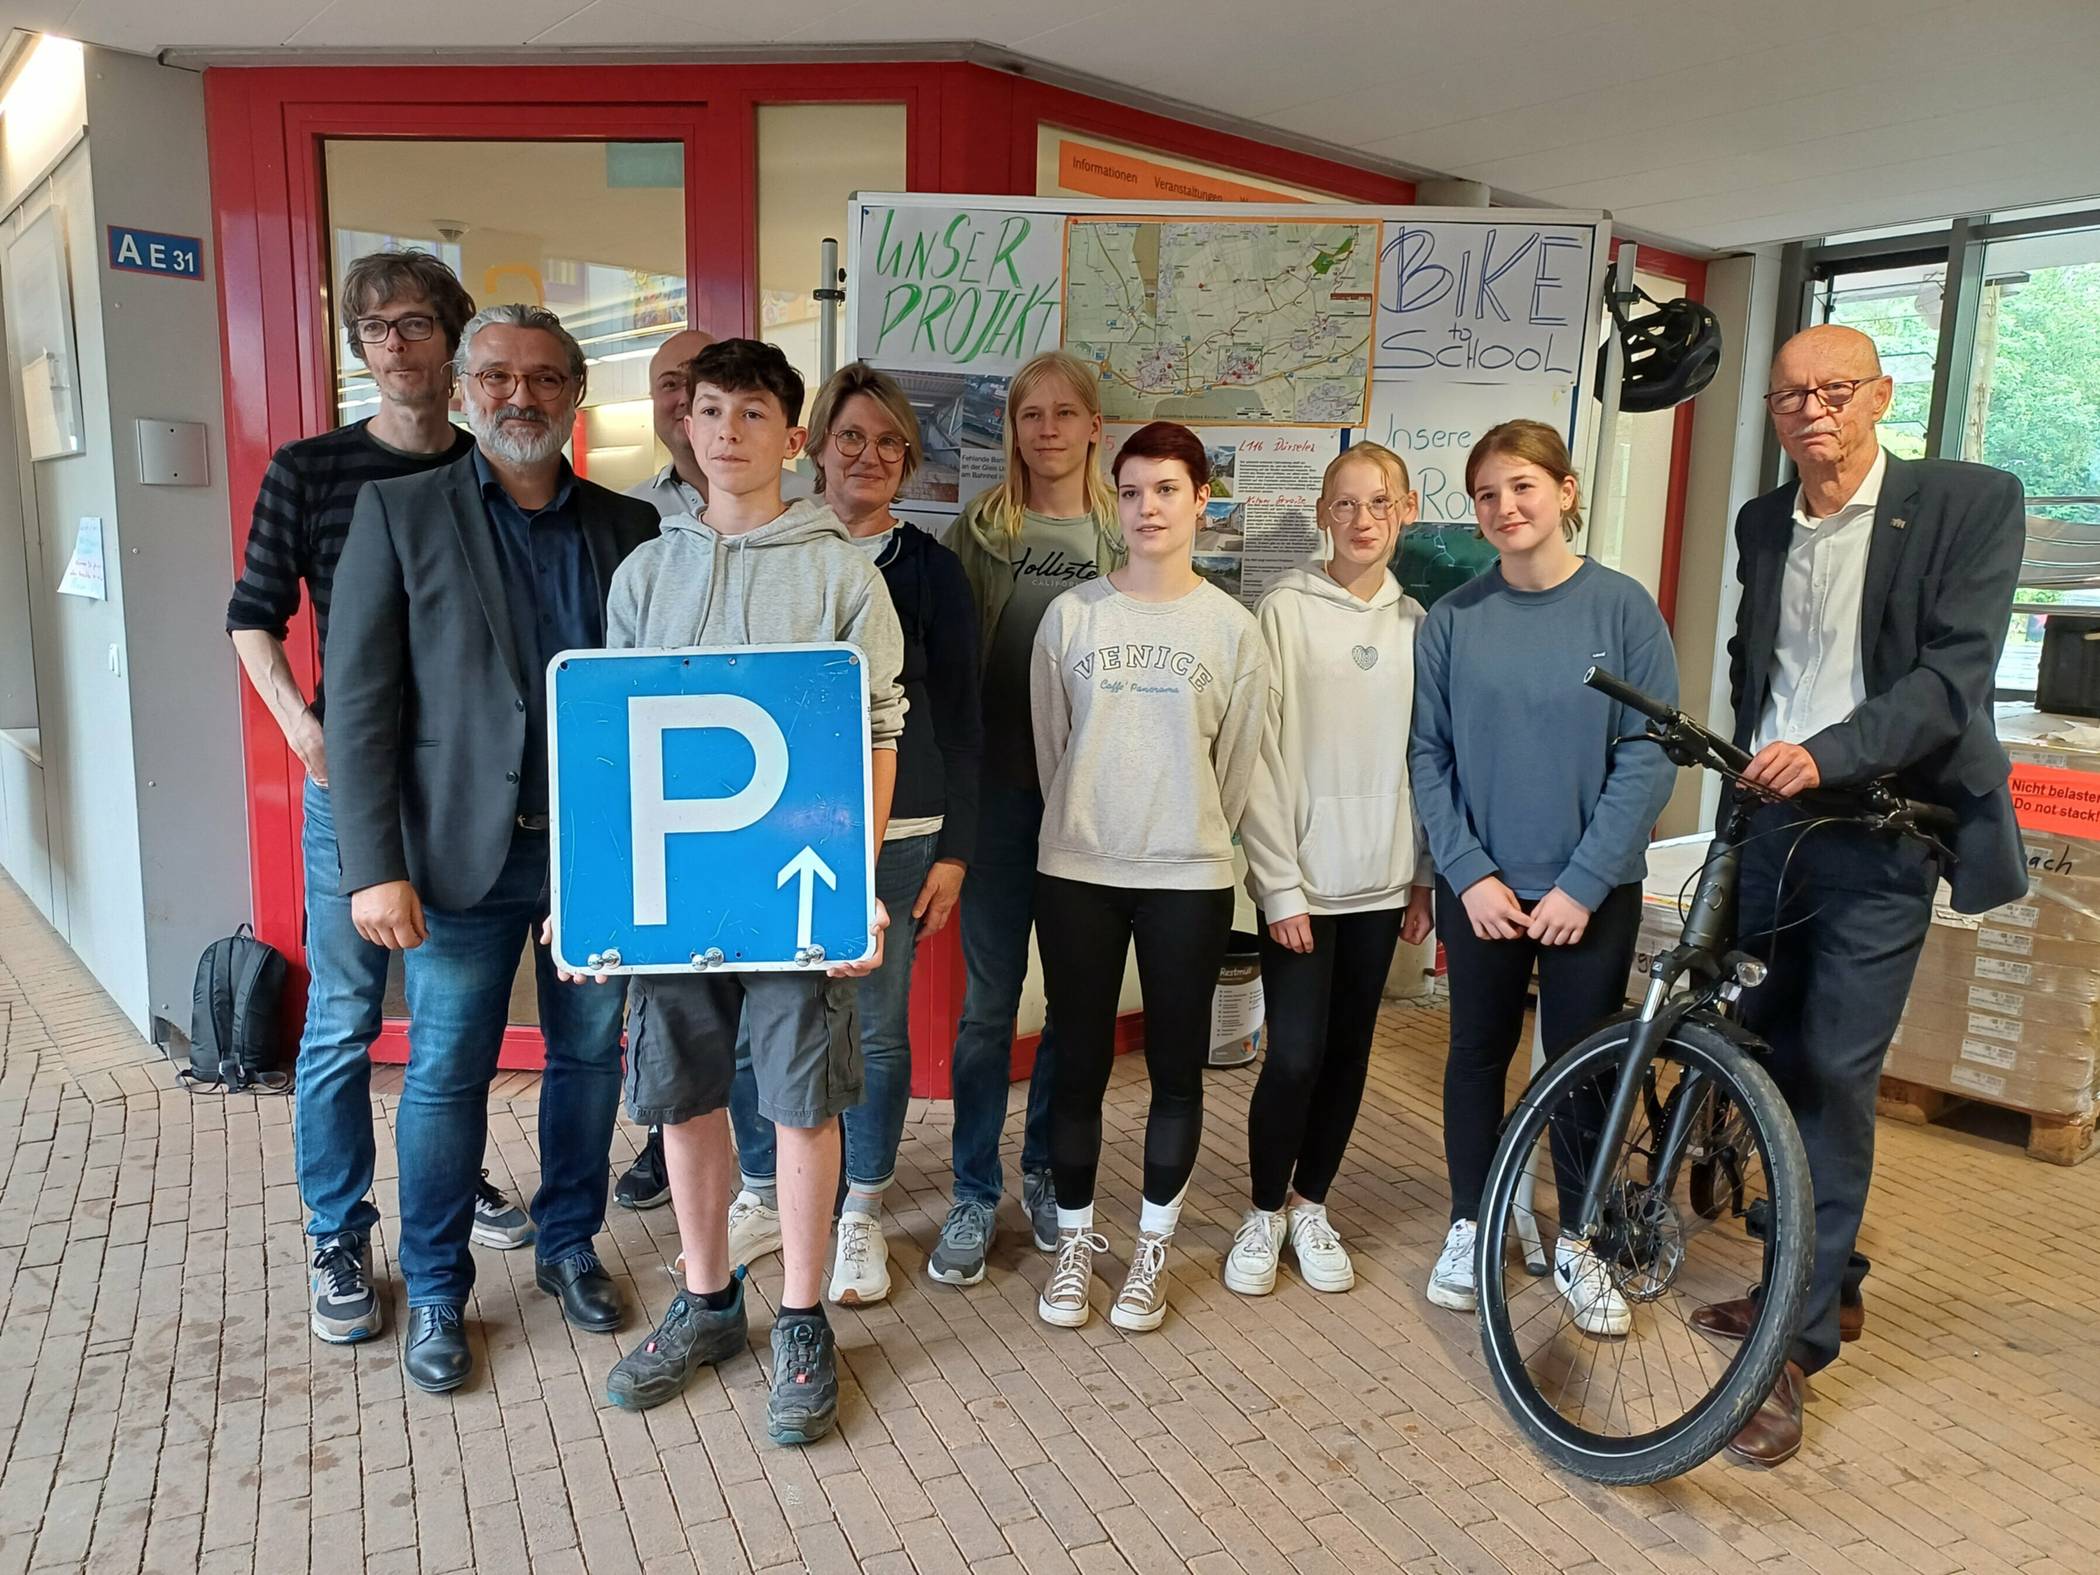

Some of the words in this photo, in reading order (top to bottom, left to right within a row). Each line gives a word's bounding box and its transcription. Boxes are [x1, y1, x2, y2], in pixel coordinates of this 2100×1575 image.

[1072, 156, 1138, 184] Informationen
[117, 233, 142, 265] A
[149, 243, 166, 268] E
[173, 250, 194, 272] 31
[876, 209, 1031, 289] UNSER
[1380, 226, 1583, 326] BIKE
[875, 277, 1061, 364] PROJEKT
[1448, 322, 1472, 342] to
[1073, 644, 1213, 693] VENICE
[2011, 779, 2047, 796] Nicht
[628, 693, 789, 926] P
[2014, 797, 2032, 811] Do
[2034, 803, 2057, 815] not
[2060, 806, 2100, 823] stack!
[2023, 844, 2073, 876] ach
